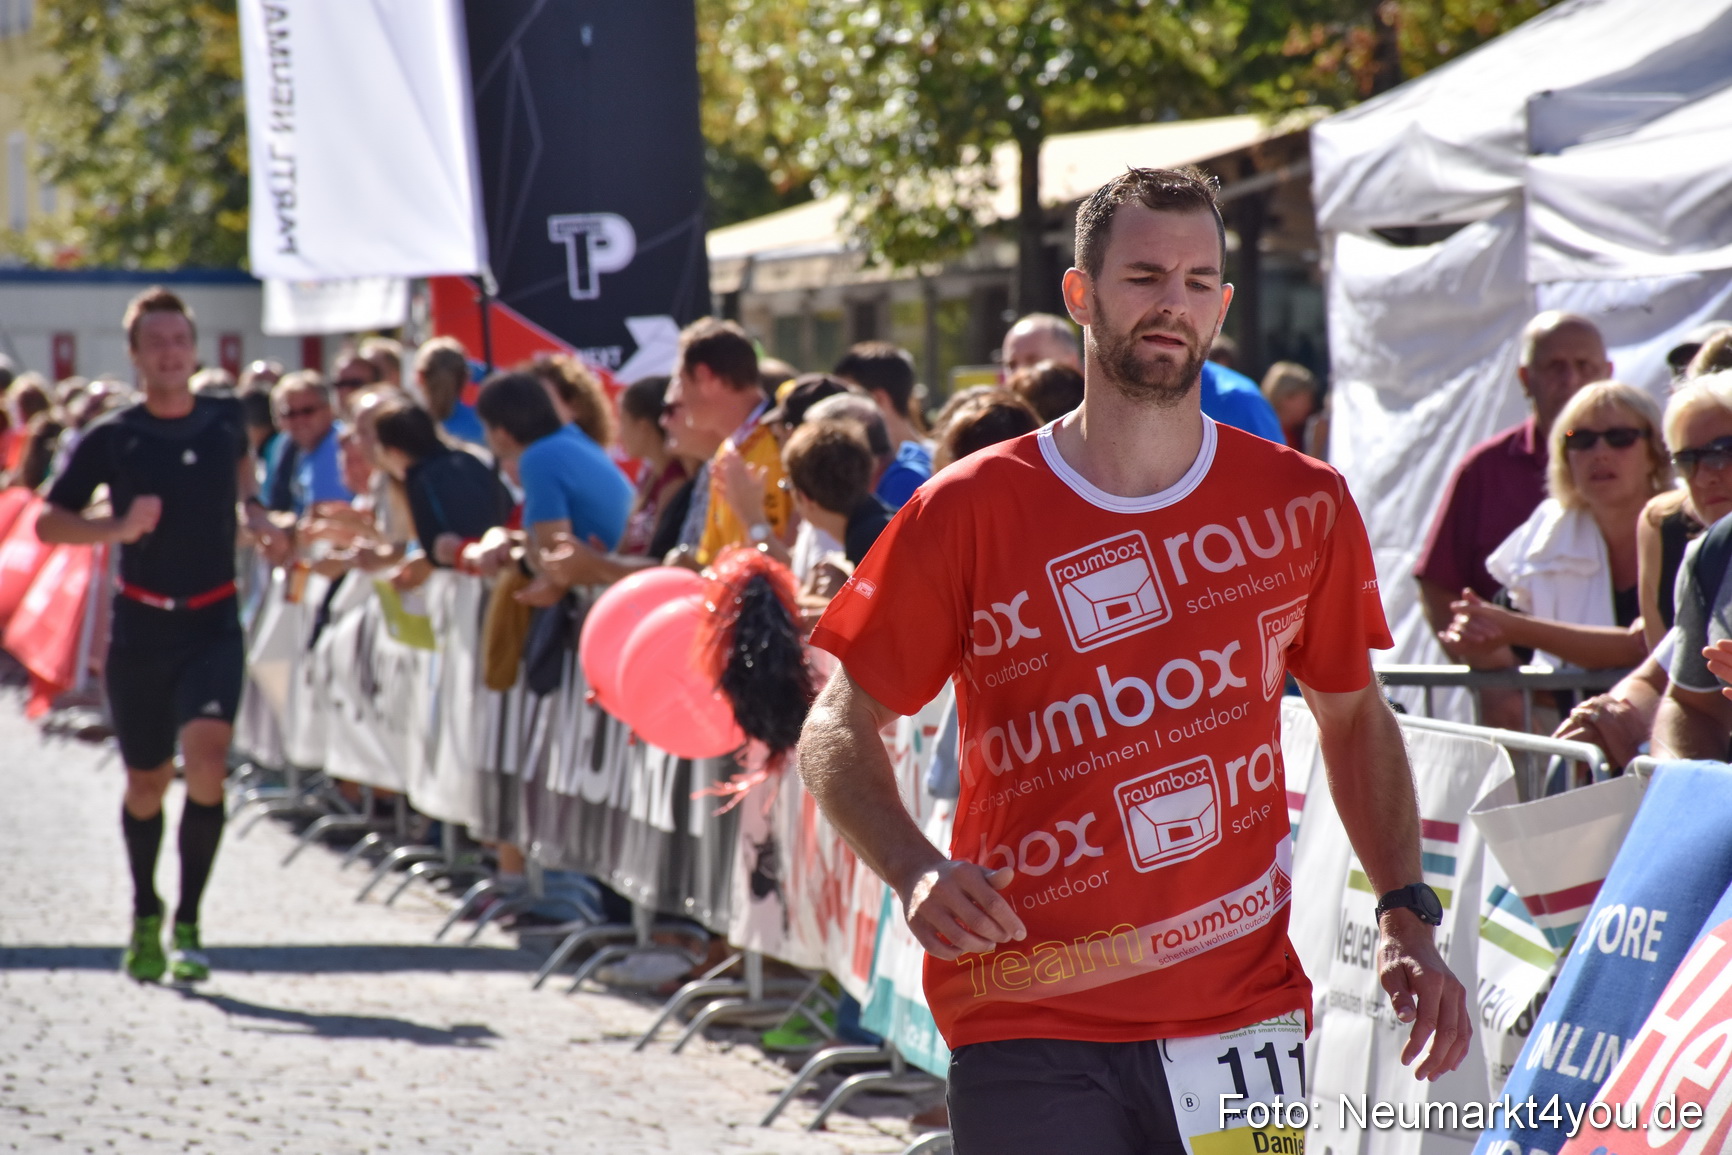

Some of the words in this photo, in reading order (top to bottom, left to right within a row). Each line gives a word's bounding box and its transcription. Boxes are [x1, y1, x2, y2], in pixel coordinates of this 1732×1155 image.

[1055, 540, 1143, 583] raumbox
[1186, 570, 1287, 614] schenken
[985, 653, 1049, 688] outdoor
[962, 640, 1247, 788] raumbox
[1058, 740, 1150, 782] wohnen
[1168, 701, 1250, 743] outdoor
[1123, 767, 1210, 806] raumbox
[1023, 869, 1111, 910] outdoor
[956, 923, 1144, 997] Team
[1150, 885, 1271, 954] raumbox
[1158, 944, 1201, 966] schenken
[1204, 927, 1239, 948] wohnen
[1244, 910, 1272, 931] outdoor
[1219, 1031, 1247, 1041] inspired
[1185, 1097, 1194, 1107] B
